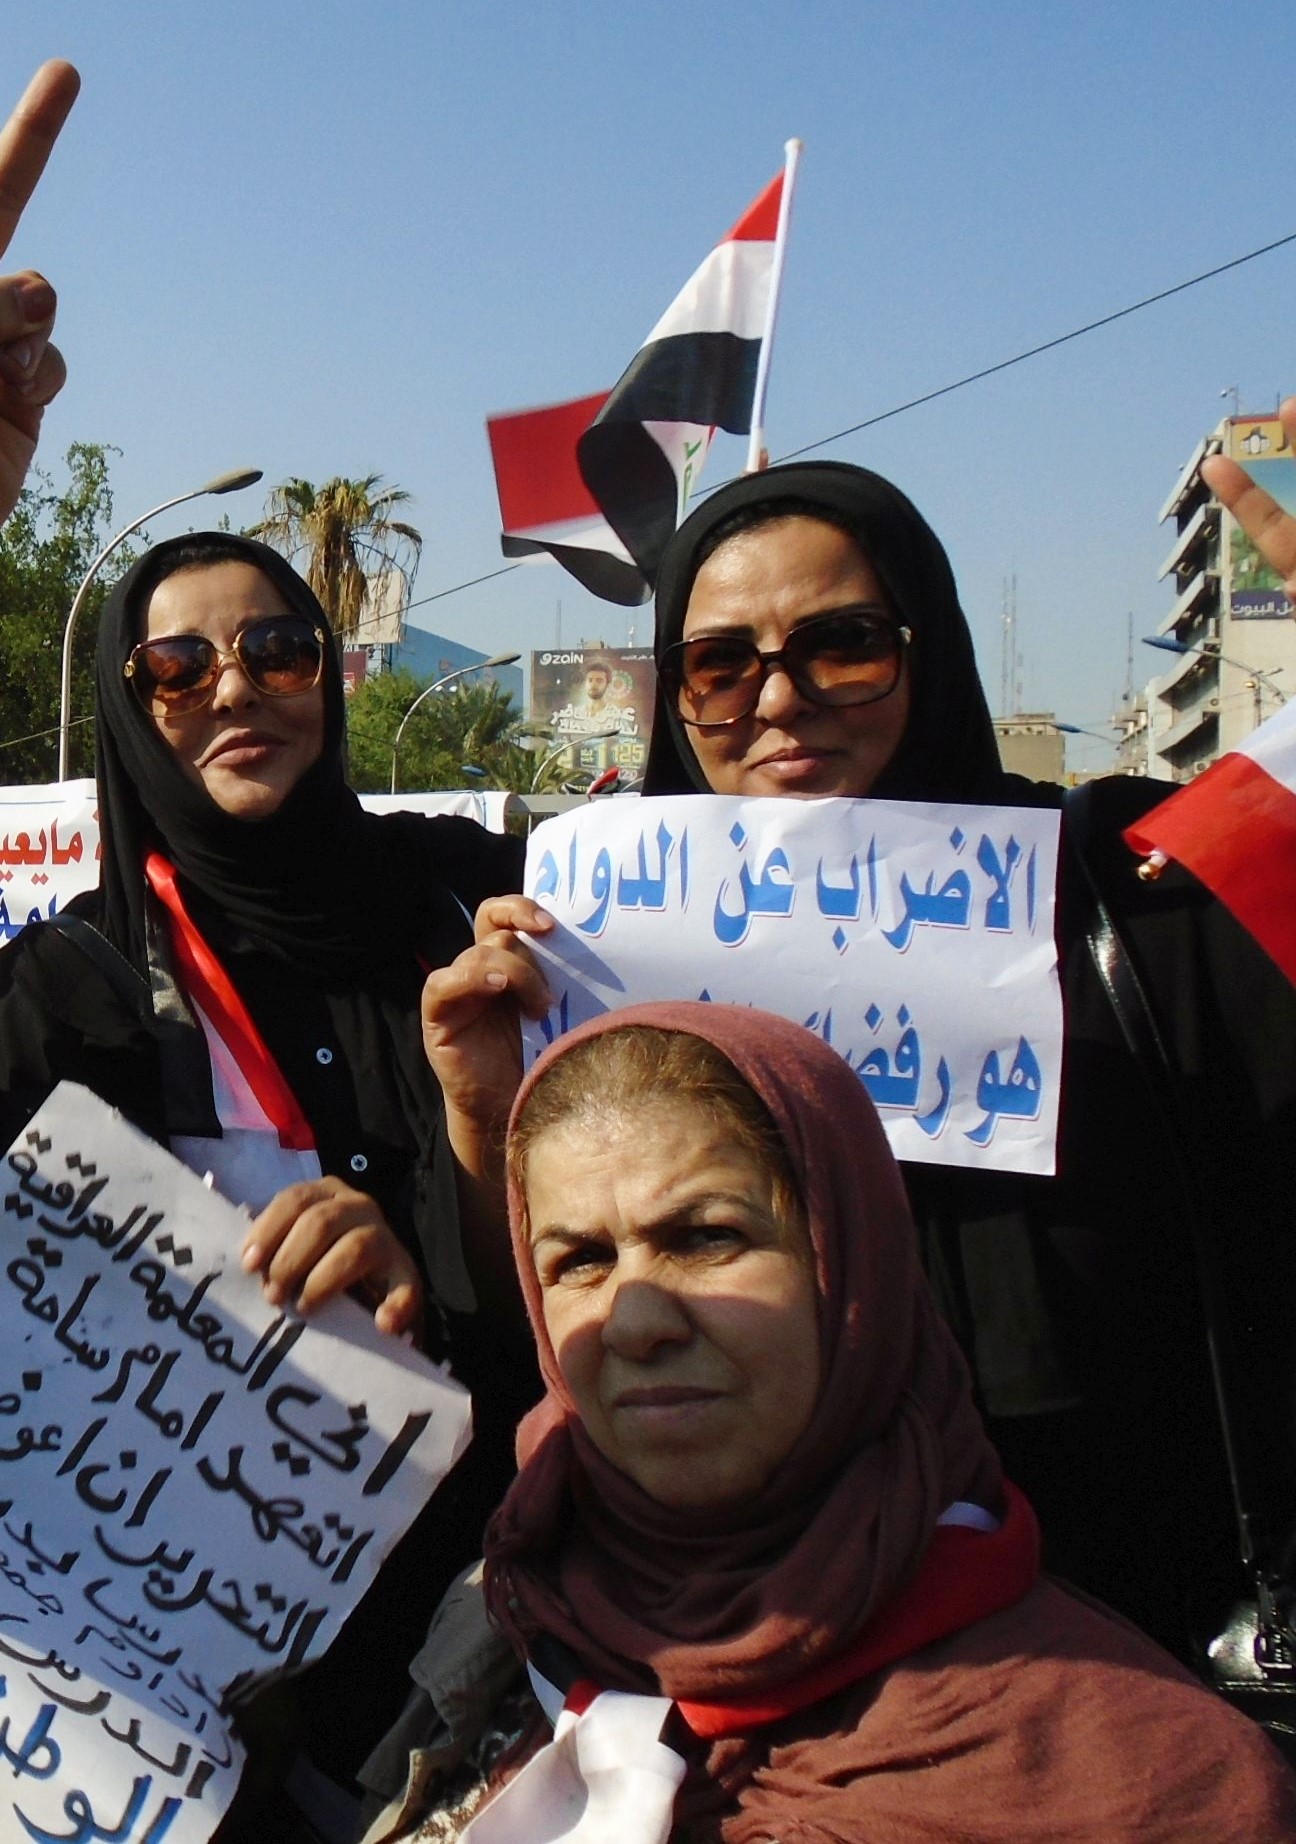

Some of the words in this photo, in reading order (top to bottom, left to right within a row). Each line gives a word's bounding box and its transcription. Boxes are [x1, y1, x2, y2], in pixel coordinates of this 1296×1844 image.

[532, 817, 689, 938] الدوام
[712, 820, 796, 947] عن
[815, 827, 1038, 953] الاضراب
[963, 1034, 1042, 1147] هو
[4, 1130, 165, 1263] العراقية
[6, 1236, 111, 1372] ساحة
[129, 1233, 308, 1392] المعلمة
[91, 1341, 225, 1452] امام
[265, 1383, 434, 1497] اني
[75, 1449, 173, 1529] ان
[196, 1445, 375, 1583] اتعهد
[93, 1524, 330, 1669] التحرير
